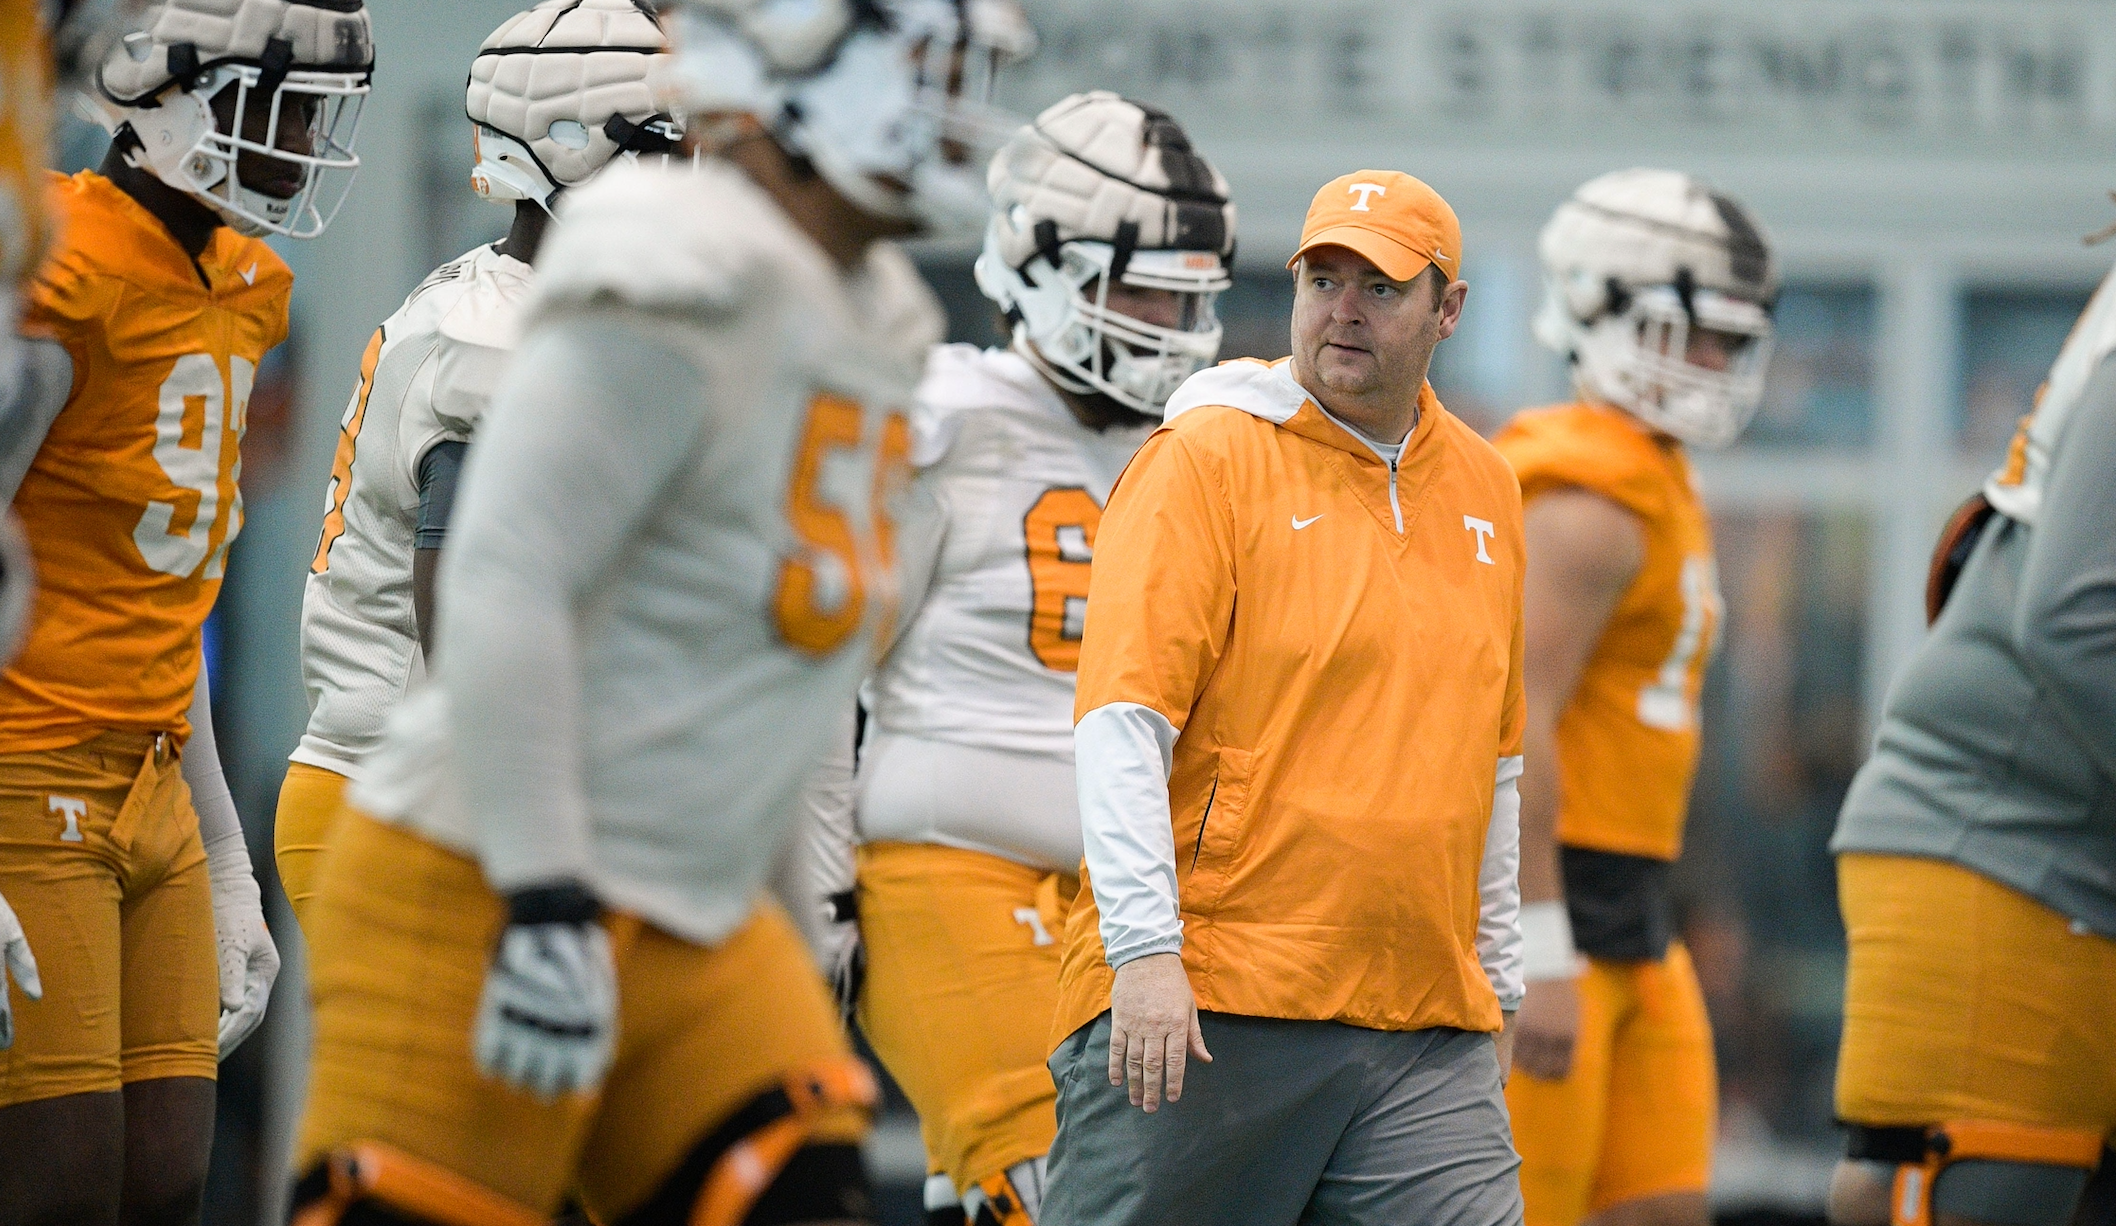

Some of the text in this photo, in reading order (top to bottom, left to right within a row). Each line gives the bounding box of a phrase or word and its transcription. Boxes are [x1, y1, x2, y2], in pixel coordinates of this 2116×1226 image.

[1348, 183, 1386, 212] T
[1463, 514, 1496, 565] T
[48, 795, 87, 842] T
